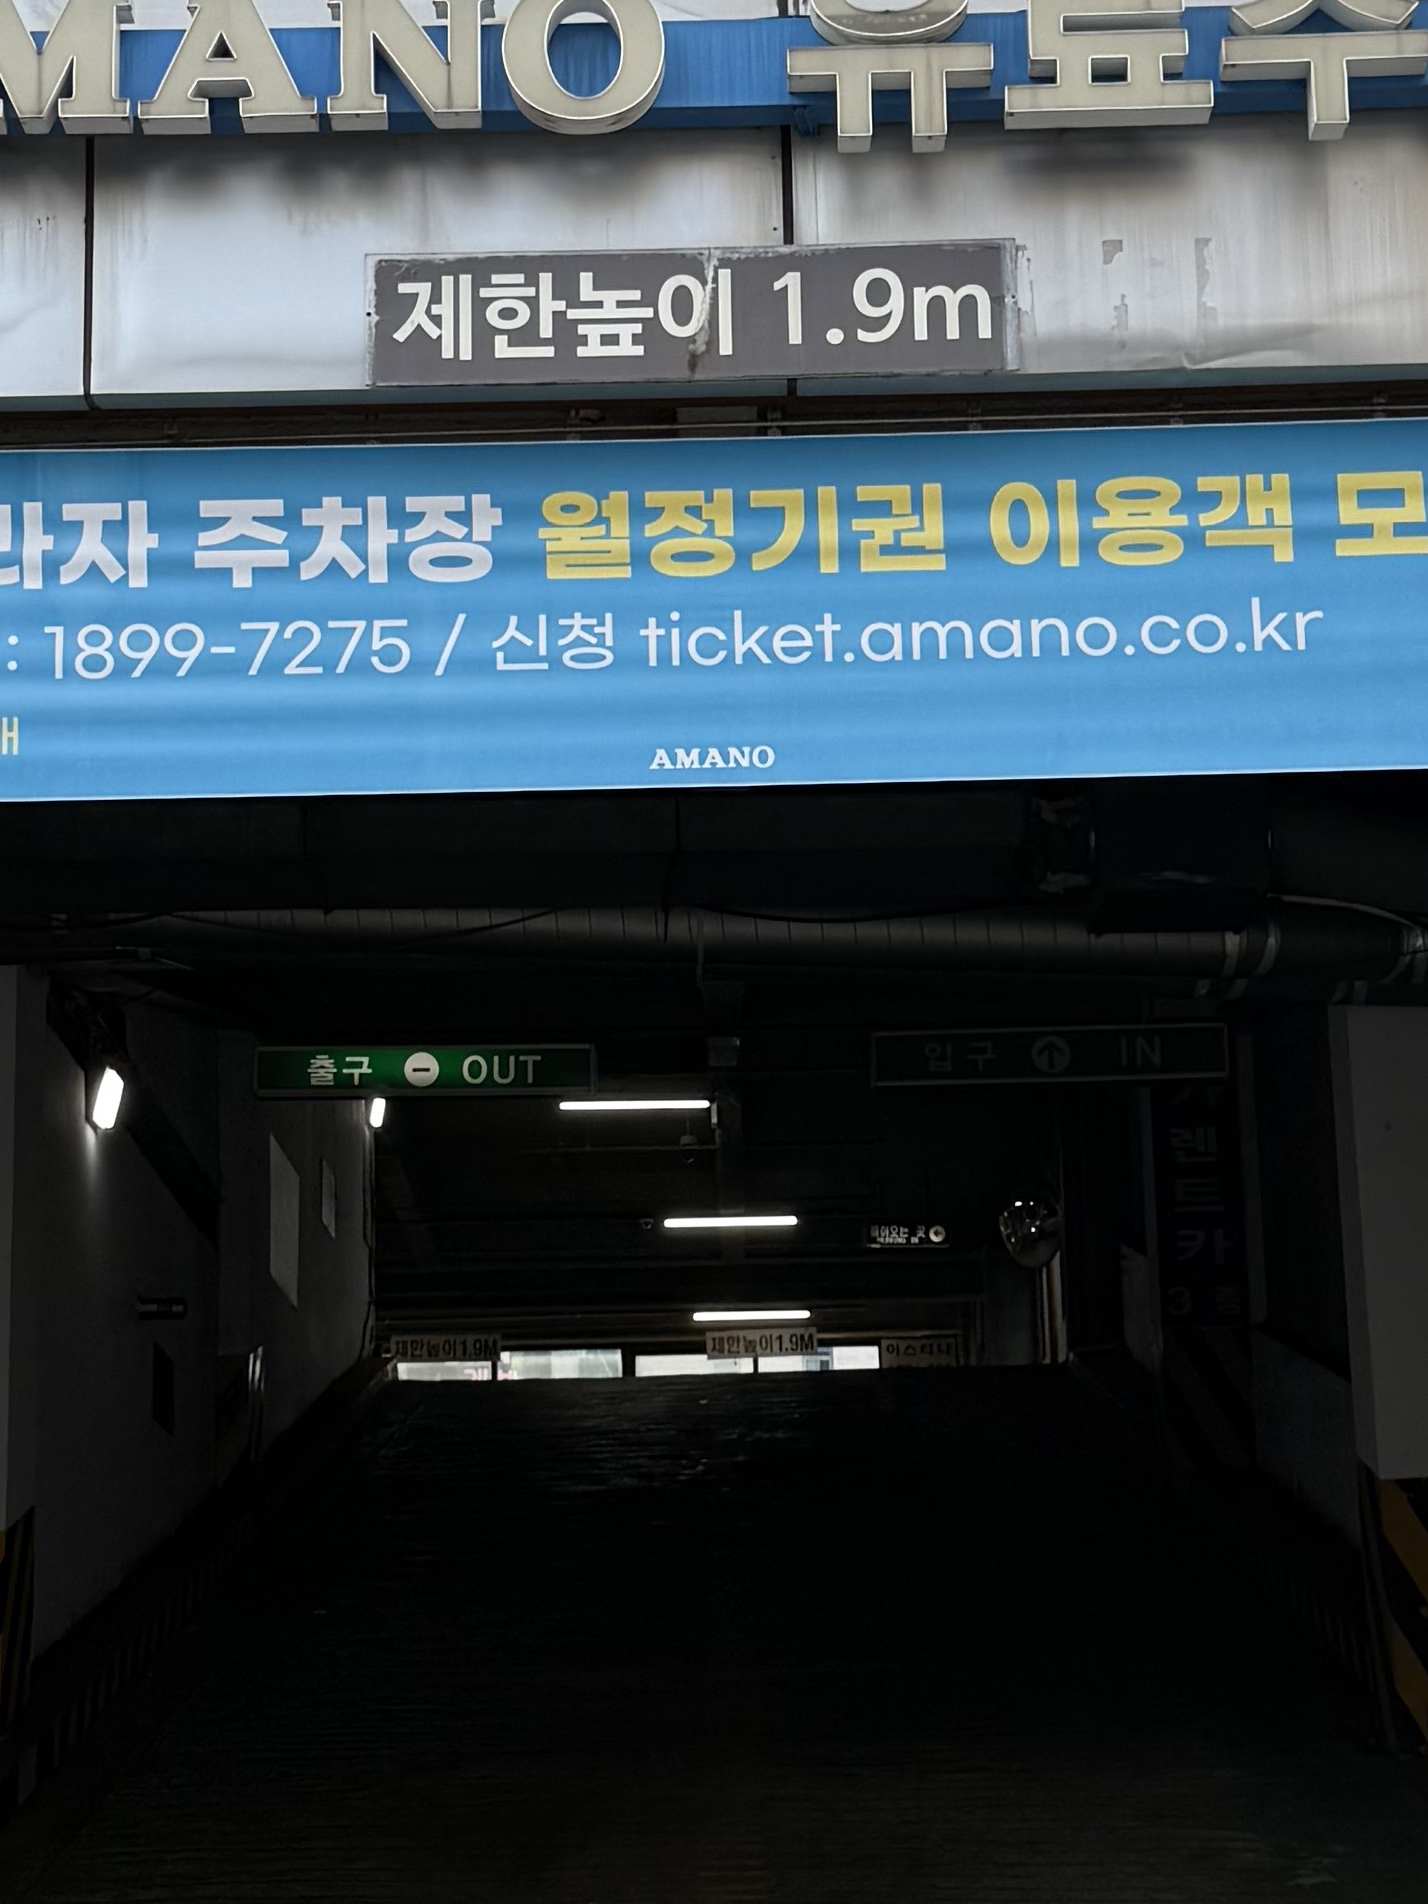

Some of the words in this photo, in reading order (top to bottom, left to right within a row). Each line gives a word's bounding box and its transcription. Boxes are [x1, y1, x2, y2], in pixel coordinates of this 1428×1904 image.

[391, 267, 732, 361] 제한높이
[773, 267, 993, 345] 1.9m
[194, 492, 502, 587] 주차장
[538, 481, 946, 580] 월정기권
[989, 471, 1294, 567] 이용객
[44, 619, 410, 681] 1899-7275
[489, 612, 614, 670] 신청
[639, 596, 1323, 669] ticket.amano.co.kr
[650, 744, 776, 771] AMANO
[307, 1054, 373, 1087] 출구
[462, 1054, 542, 1085] OUT
